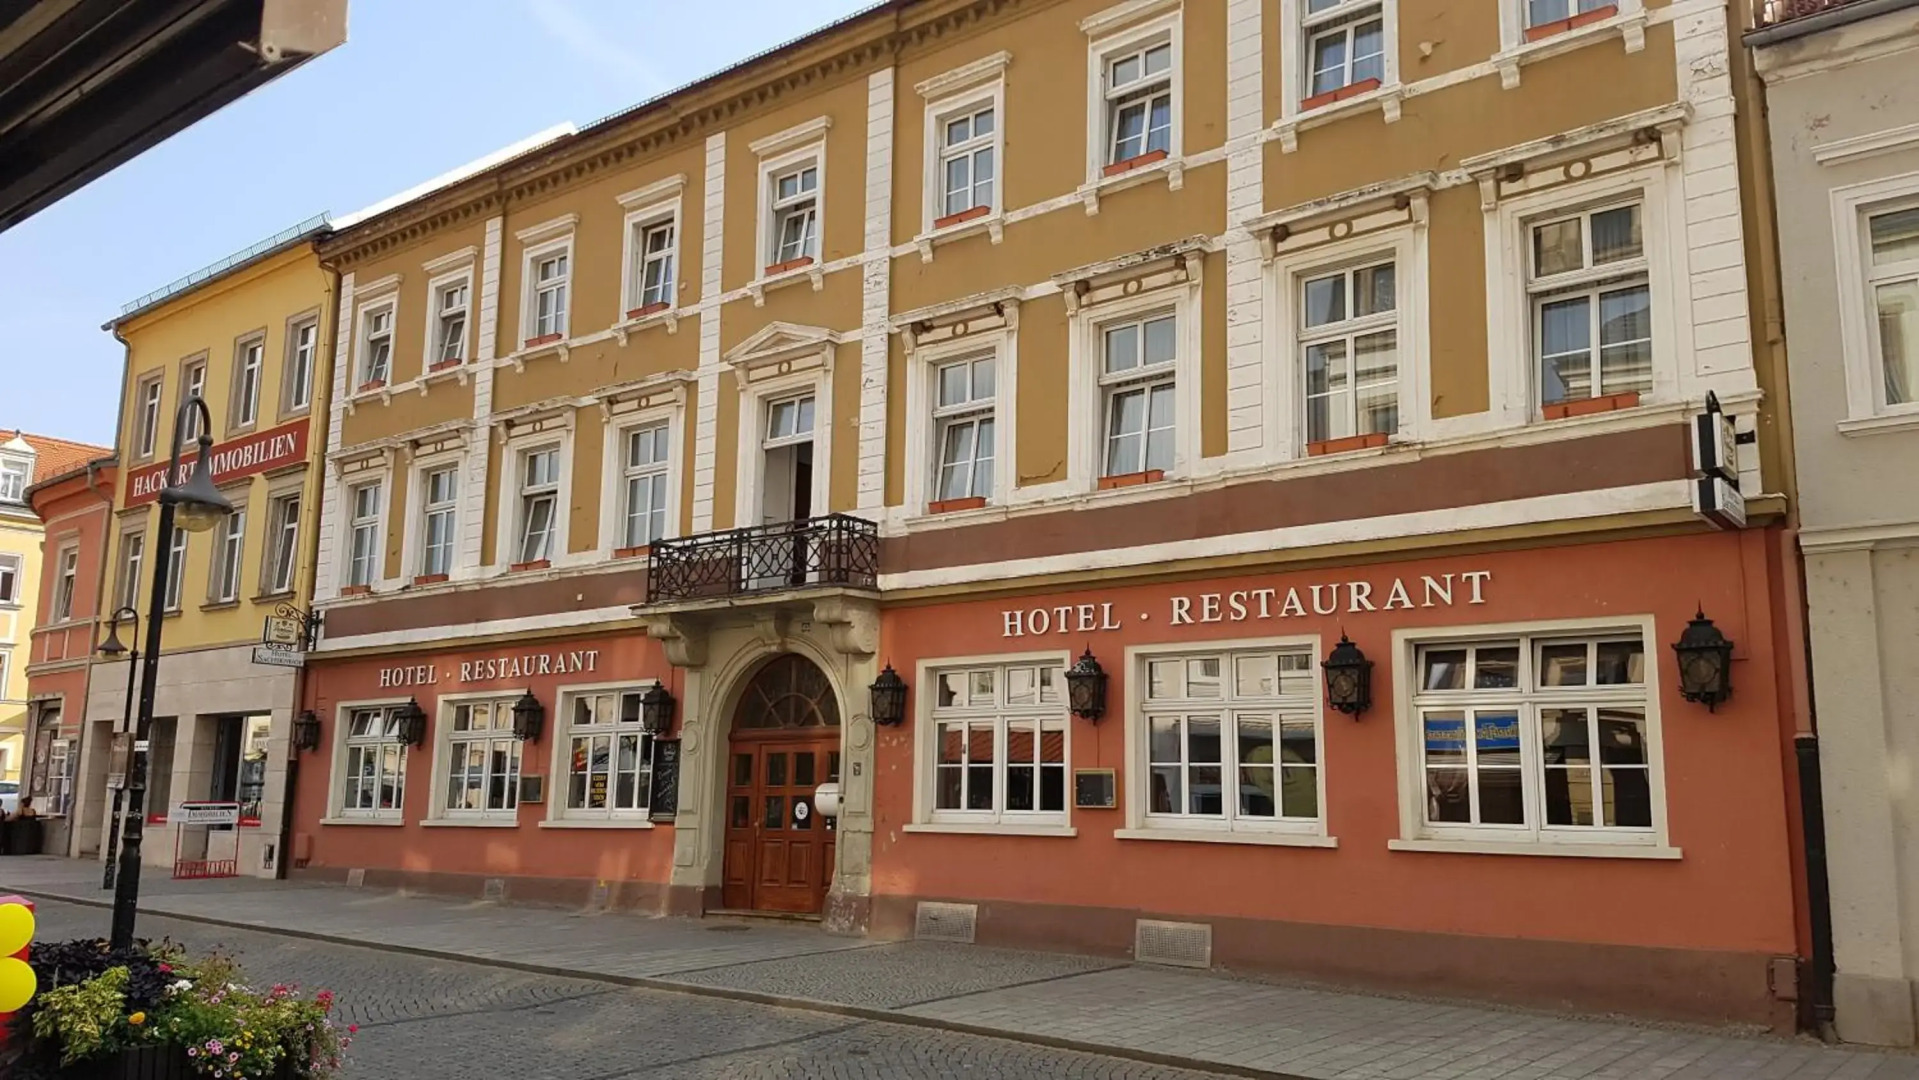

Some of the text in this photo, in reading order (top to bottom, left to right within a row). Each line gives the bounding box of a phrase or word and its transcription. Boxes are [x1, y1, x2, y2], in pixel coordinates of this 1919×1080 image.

[132, 431, 298, 497] HACKRT MMOBILIEN
[1001, 570, 1491, 638] HOTEL RESTAURANT
[379, 650, 599, 687] HOTEL RESTAURANT
